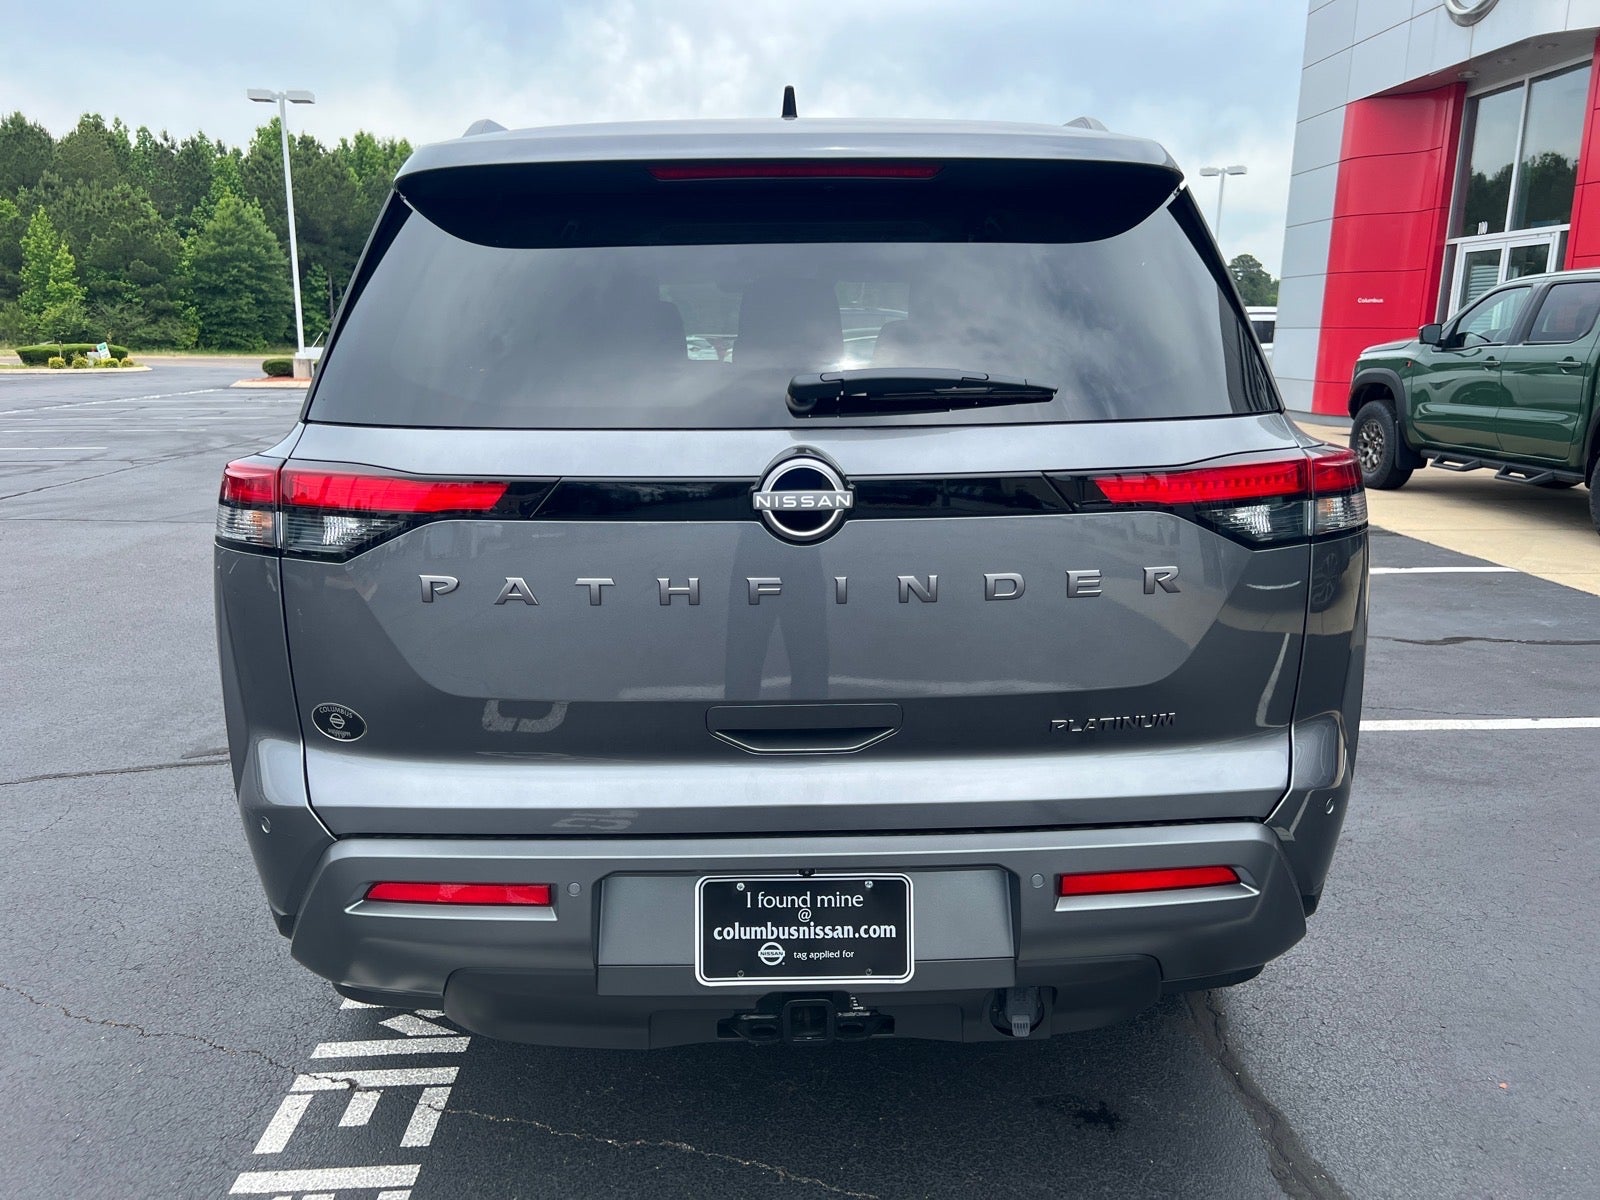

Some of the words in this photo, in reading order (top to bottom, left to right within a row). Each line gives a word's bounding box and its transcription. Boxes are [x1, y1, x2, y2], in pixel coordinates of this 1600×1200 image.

[756, 494, 851, 508] NISSAN
[418, 565, 1181, 606] PATHFINDER
[319, 706, 353, 719] COLUMBUS
[1050, 712, 1176, 733] PLATINUM
[746, 891, 751, 908] I
[758, 891, 811, 908] found
[816, 891, 864, 908] mine
[797, 908, 812, 922] @
[713, 921, 897, 940] columbusnissan.com
[793, 951, 808, 961] tag
[809, 950, 840, 960] applied
[842, 949, 855, 958] for
